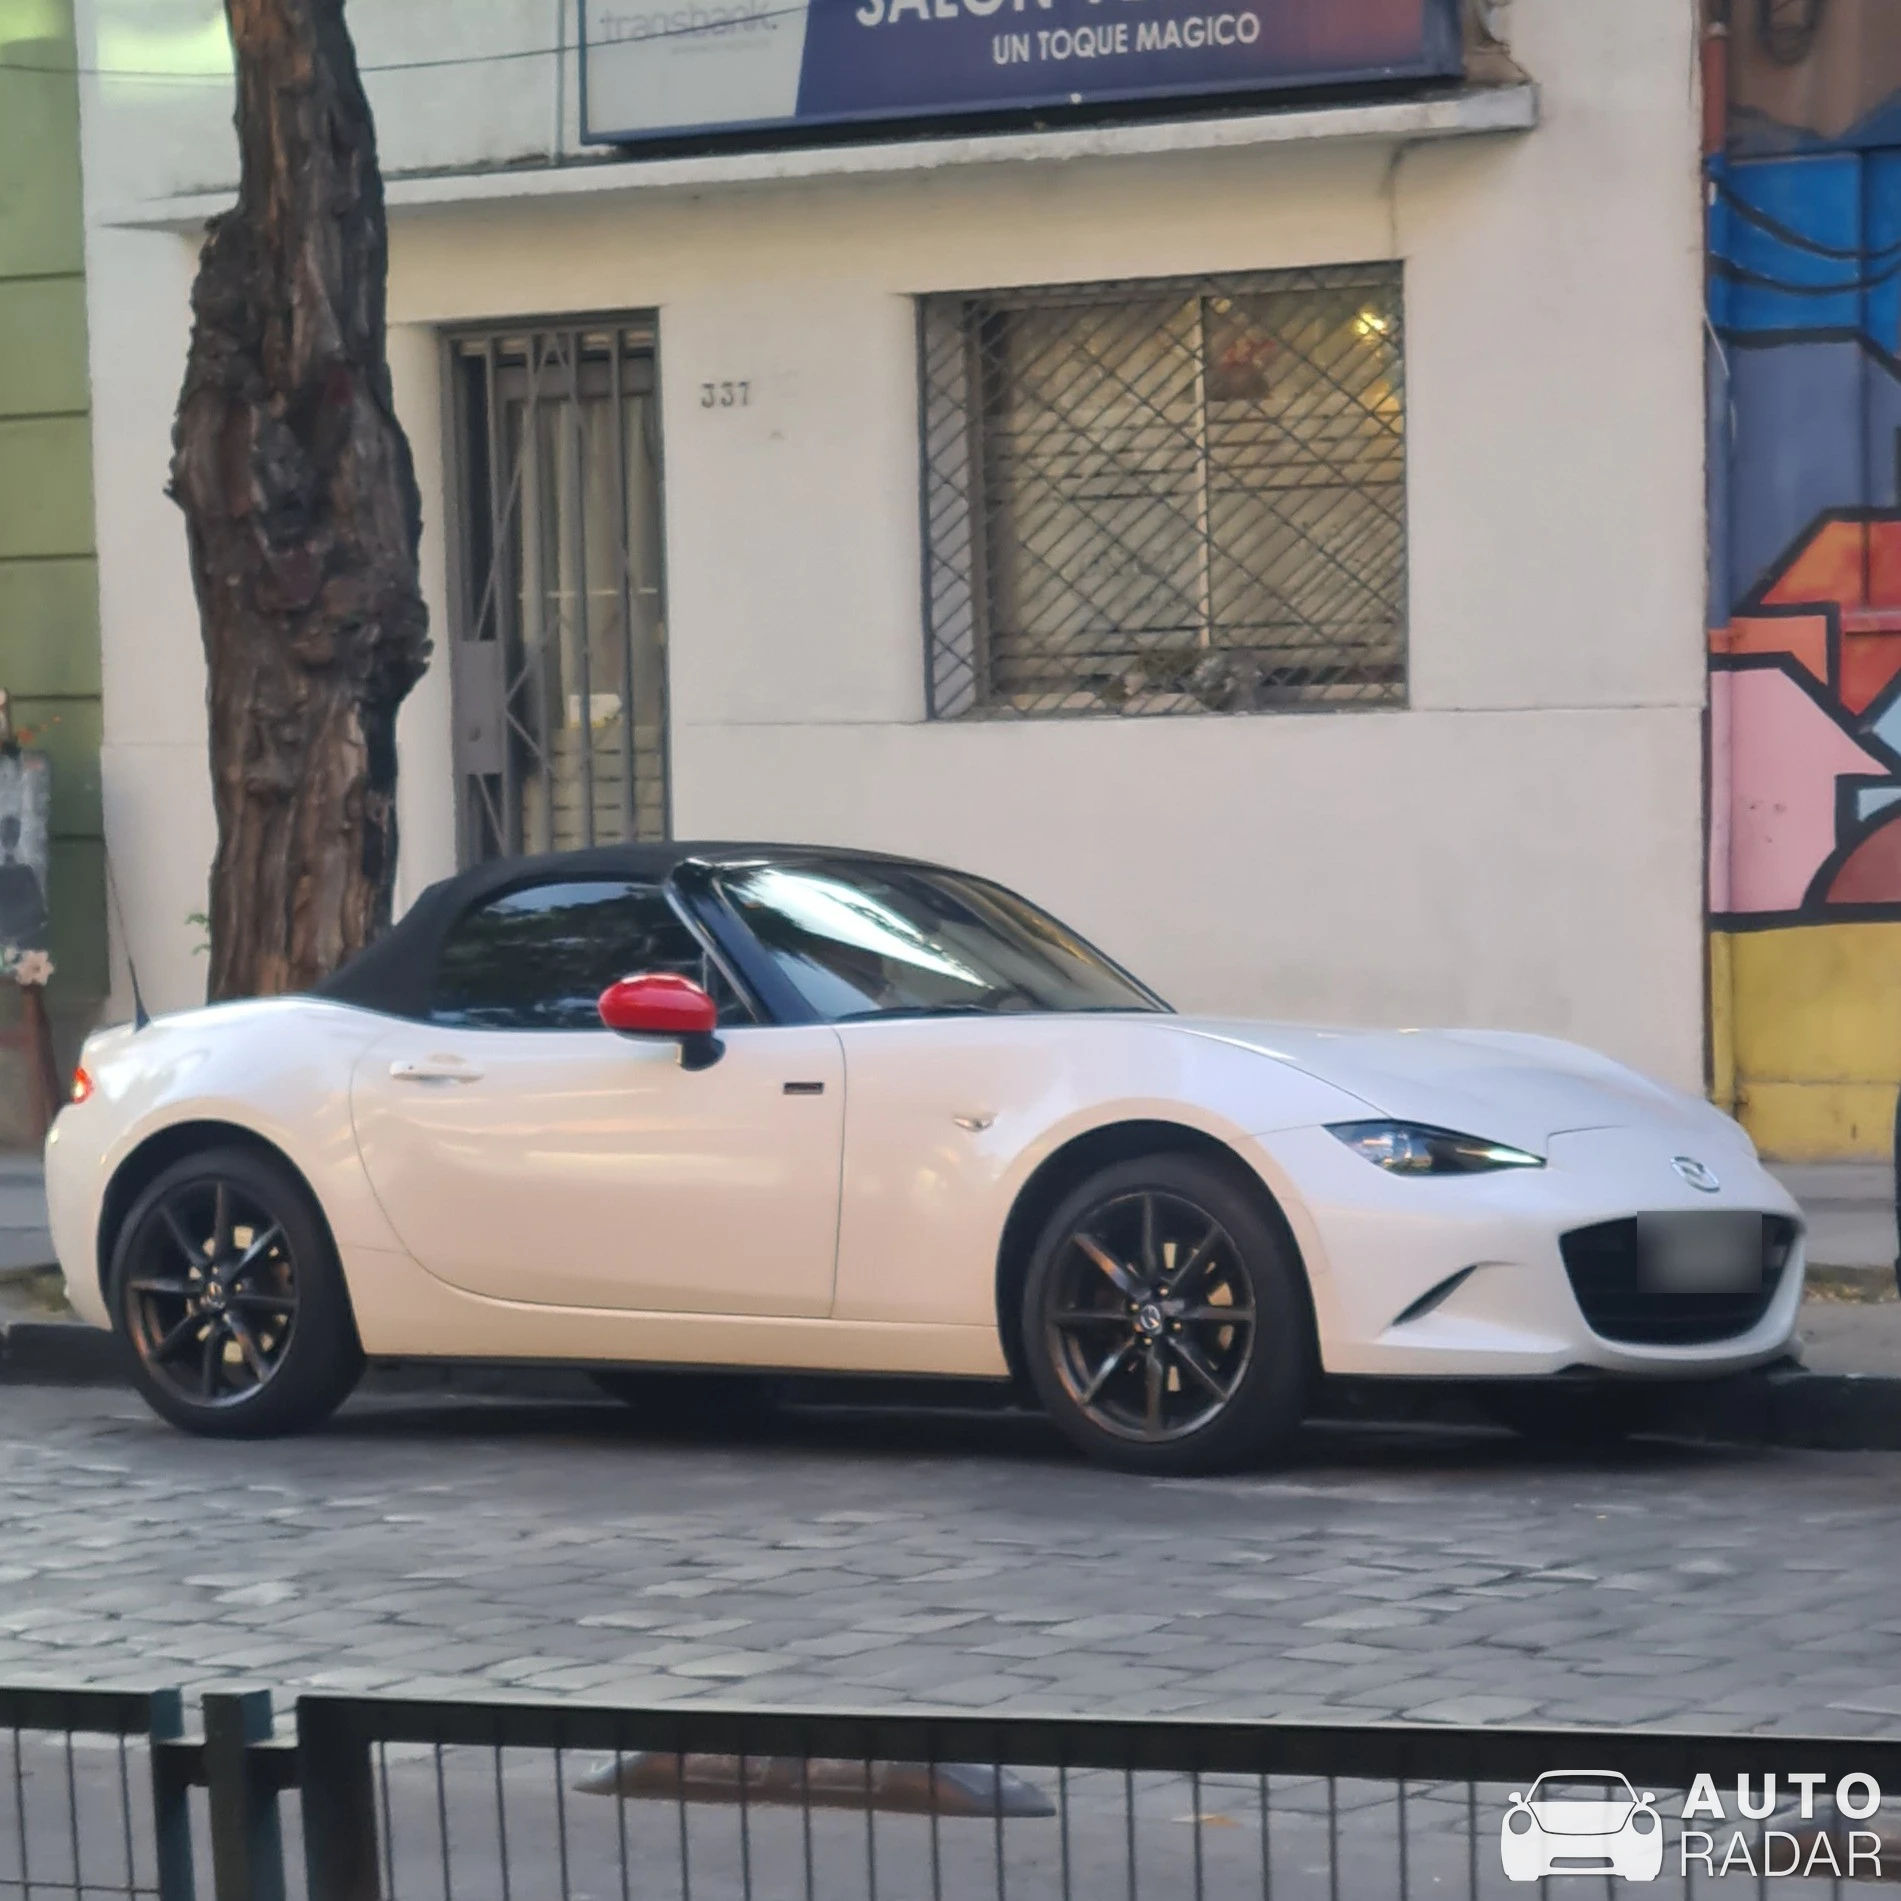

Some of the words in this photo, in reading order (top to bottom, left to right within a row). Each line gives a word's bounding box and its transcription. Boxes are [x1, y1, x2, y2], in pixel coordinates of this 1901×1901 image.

[992, 33, 1029, 65] UN
[1037, 23, 1128, 61] TOQUE
[1136, 11, 1260, 52] MAGICO
[701, 381, 750, 408] 337
